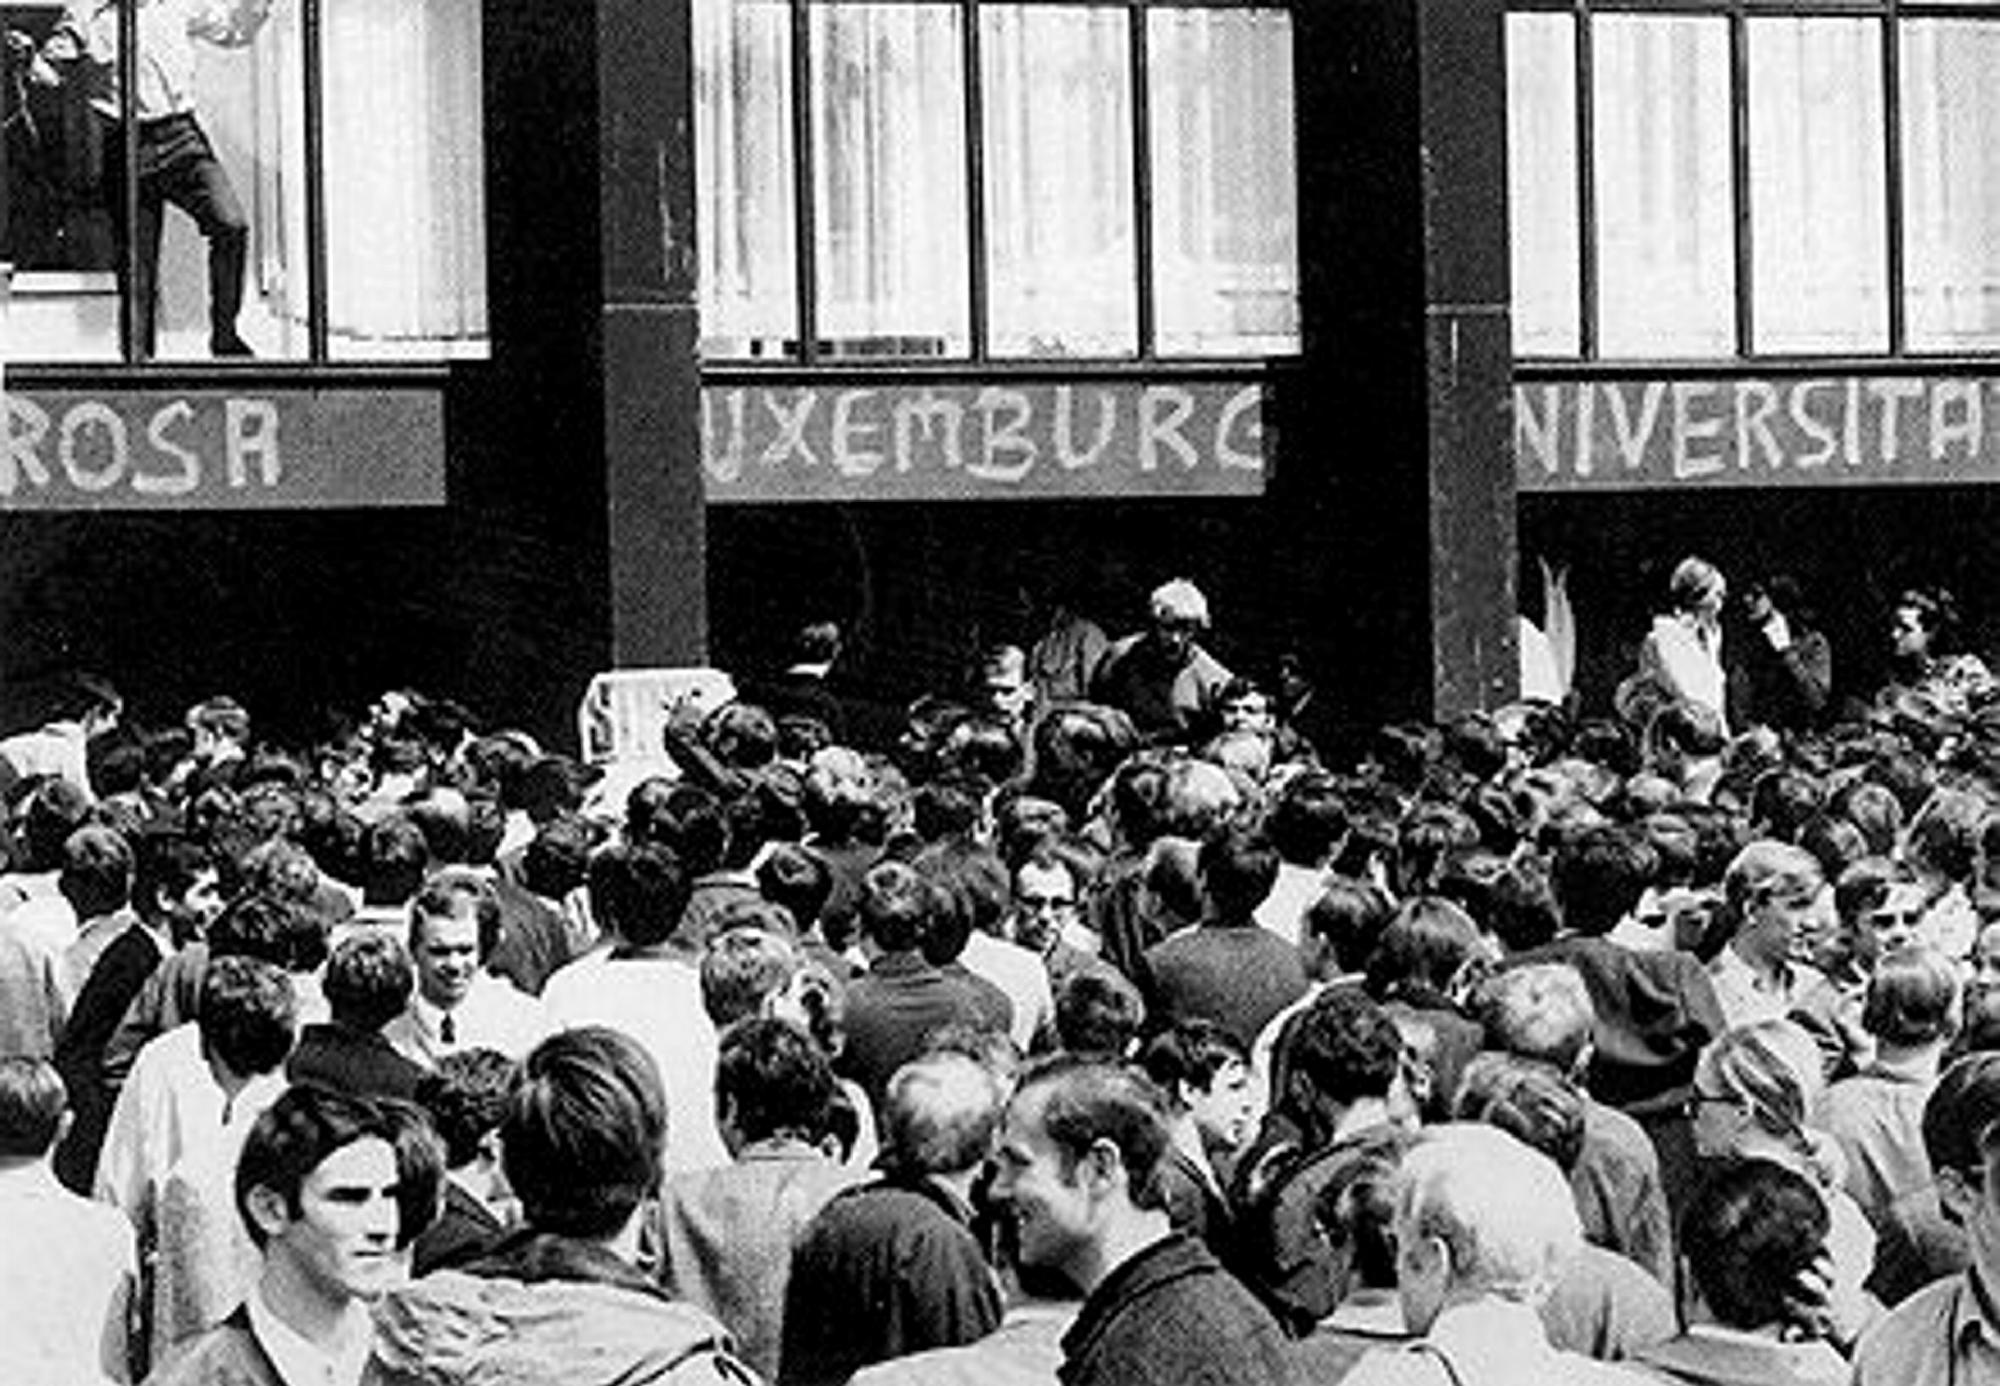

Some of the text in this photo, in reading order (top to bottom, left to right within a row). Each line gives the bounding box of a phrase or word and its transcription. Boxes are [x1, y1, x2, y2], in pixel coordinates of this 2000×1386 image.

[0, 396, 282, 494] ROSA
[701, 384, 1263, 481] UXEMBURG
[1515, 377, 2000, 479] NIVERSITA
